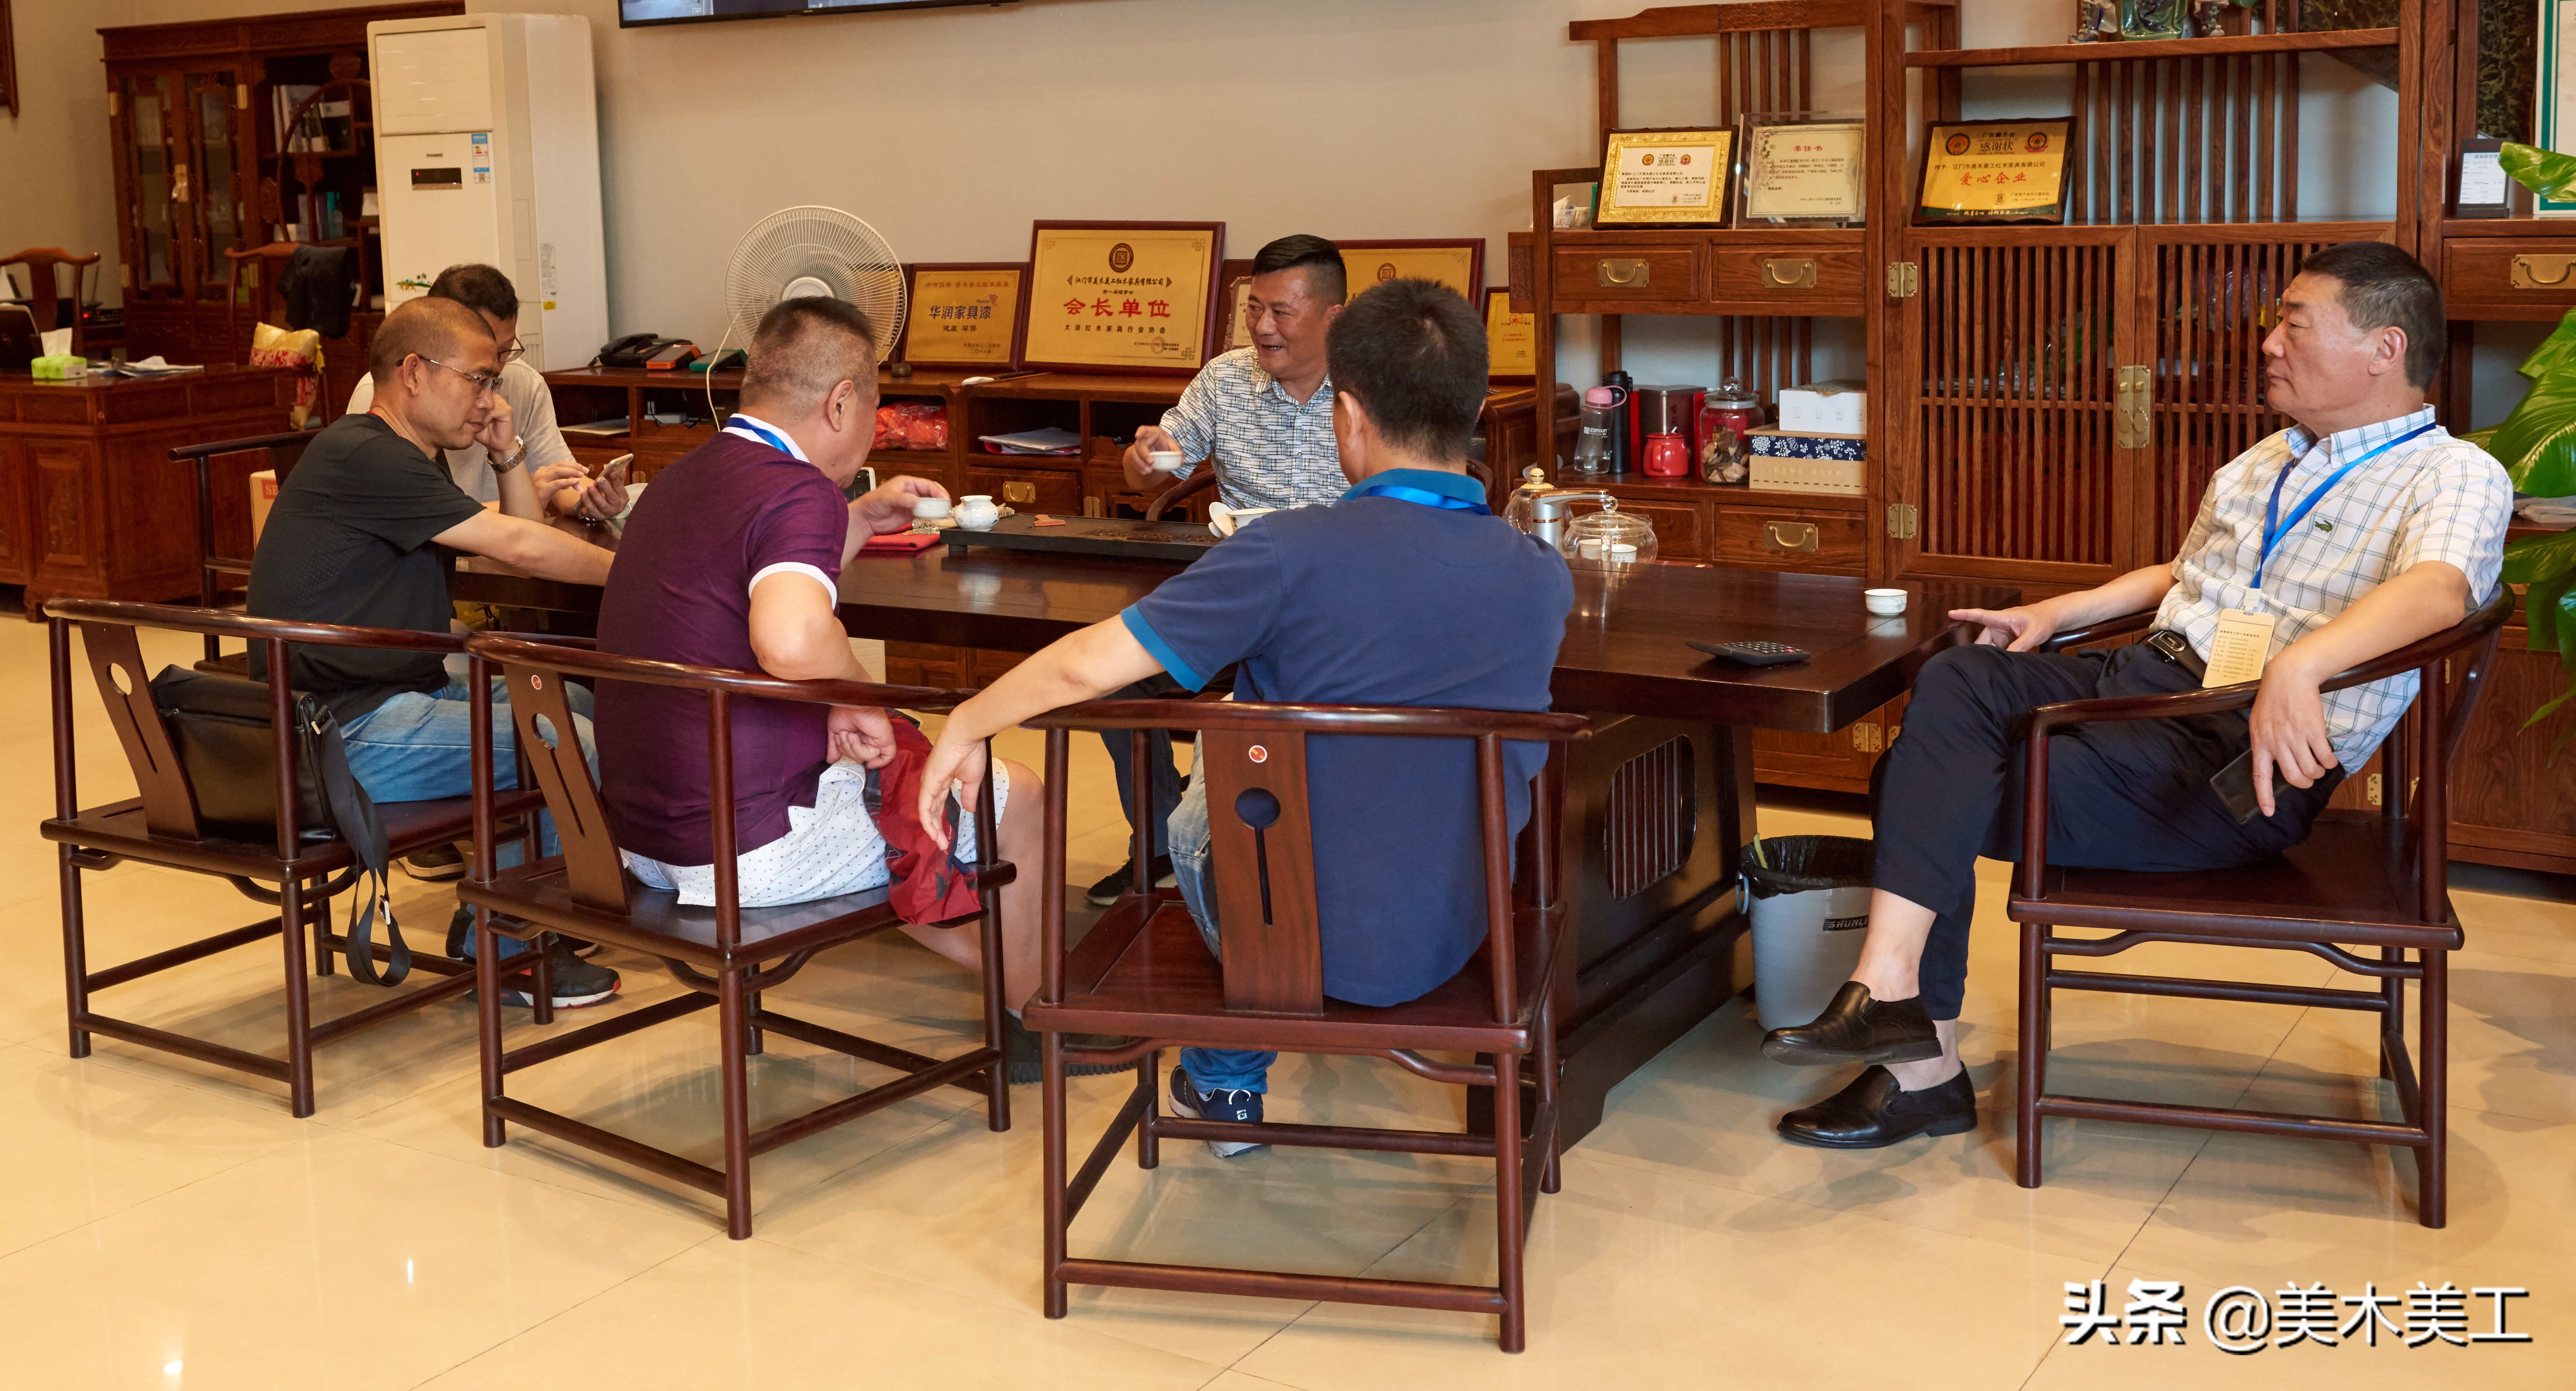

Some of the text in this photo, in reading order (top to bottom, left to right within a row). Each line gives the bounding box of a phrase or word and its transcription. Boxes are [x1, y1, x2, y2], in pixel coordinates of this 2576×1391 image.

[1980, 140, 2013, 152] 感谢状
[1960, 171, 2027, 186] 爱心企业
[1075, 277, 1164, 286] 江门市美木美工红木家具有限公司
[929, 306, 992, 320] 华润家具漆
[1063, 298, 1171, 318] 会长单位
[1065, 324, 1165, 334] 大泽红木家具行业协会
